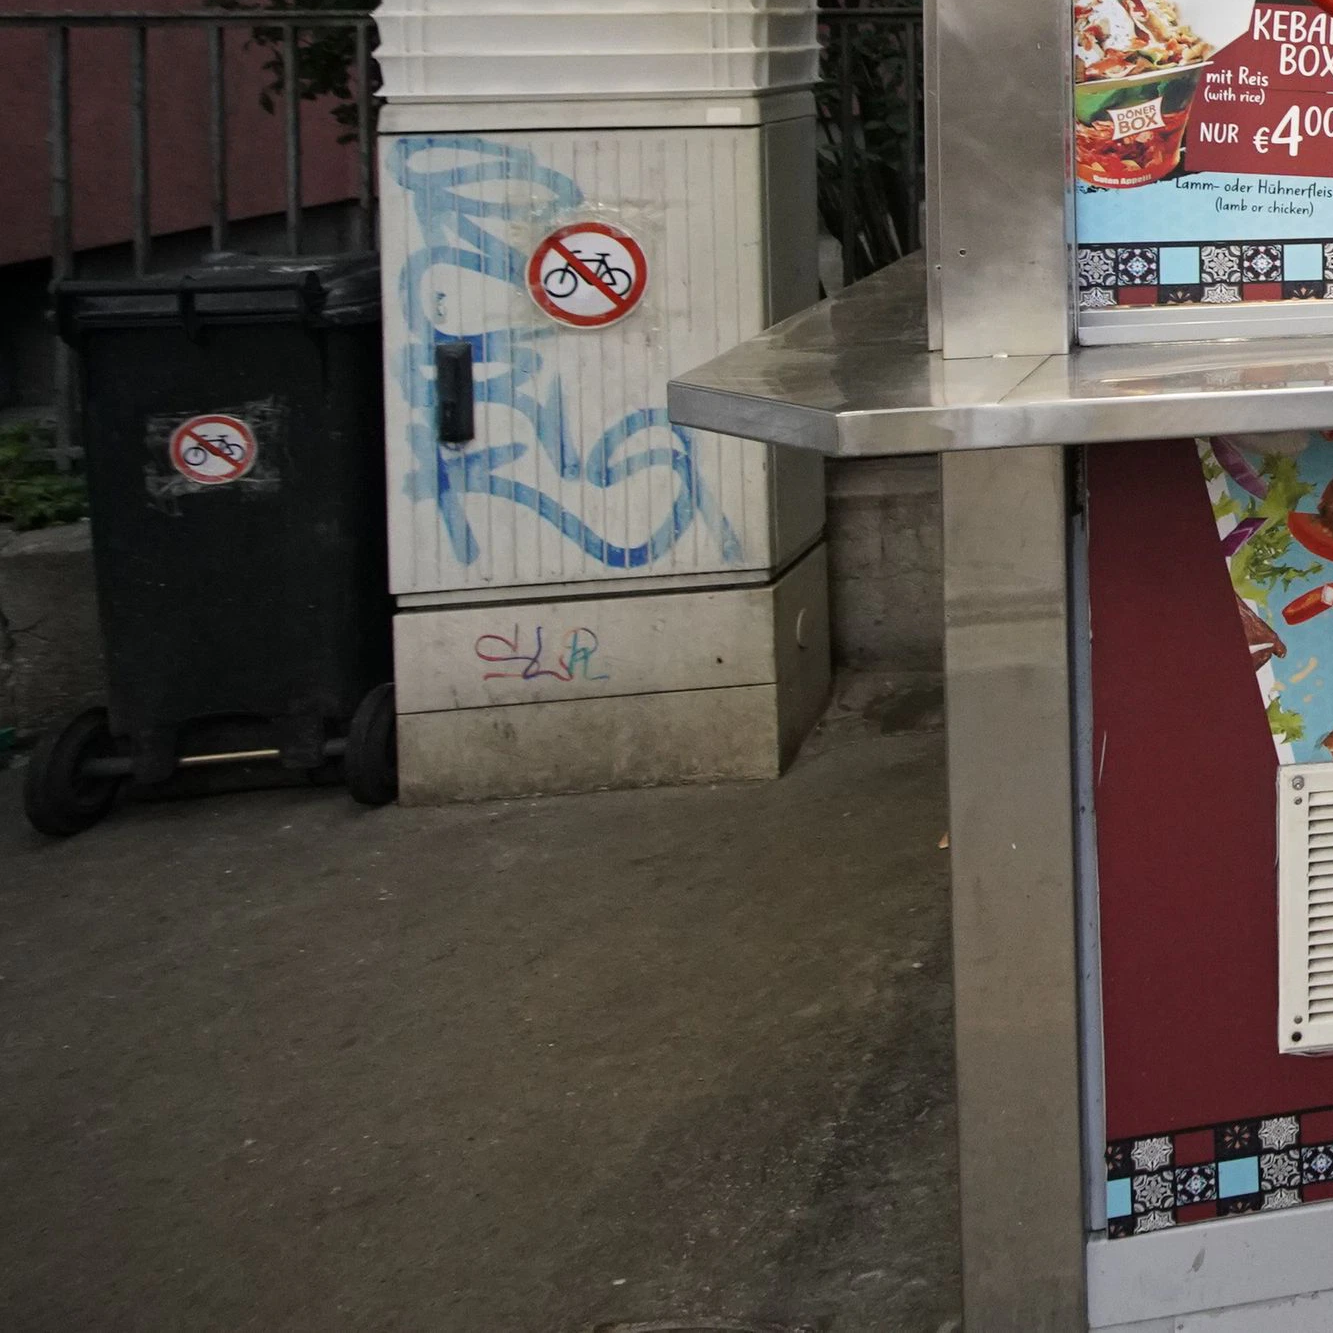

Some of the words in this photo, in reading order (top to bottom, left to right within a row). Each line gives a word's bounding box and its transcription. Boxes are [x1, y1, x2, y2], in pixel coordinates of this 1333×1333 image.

[1206, 69, 1233, 85] mit
[1238, 66, 1269, 87] Reis
[1204, 87, 1236, 104] (with
[1240, 89, 1265, 105] rice)
[1117, 104, 1157, 121] DÖNER
[1119, 113, 1159, 134] BOX
[1200, 122, 1239, 144] NUR
[1224, 181, 1253, 194] oder
[1215, 201, 1247, 213] (lamb
[1267, 201, 1314, 217] chicken)
